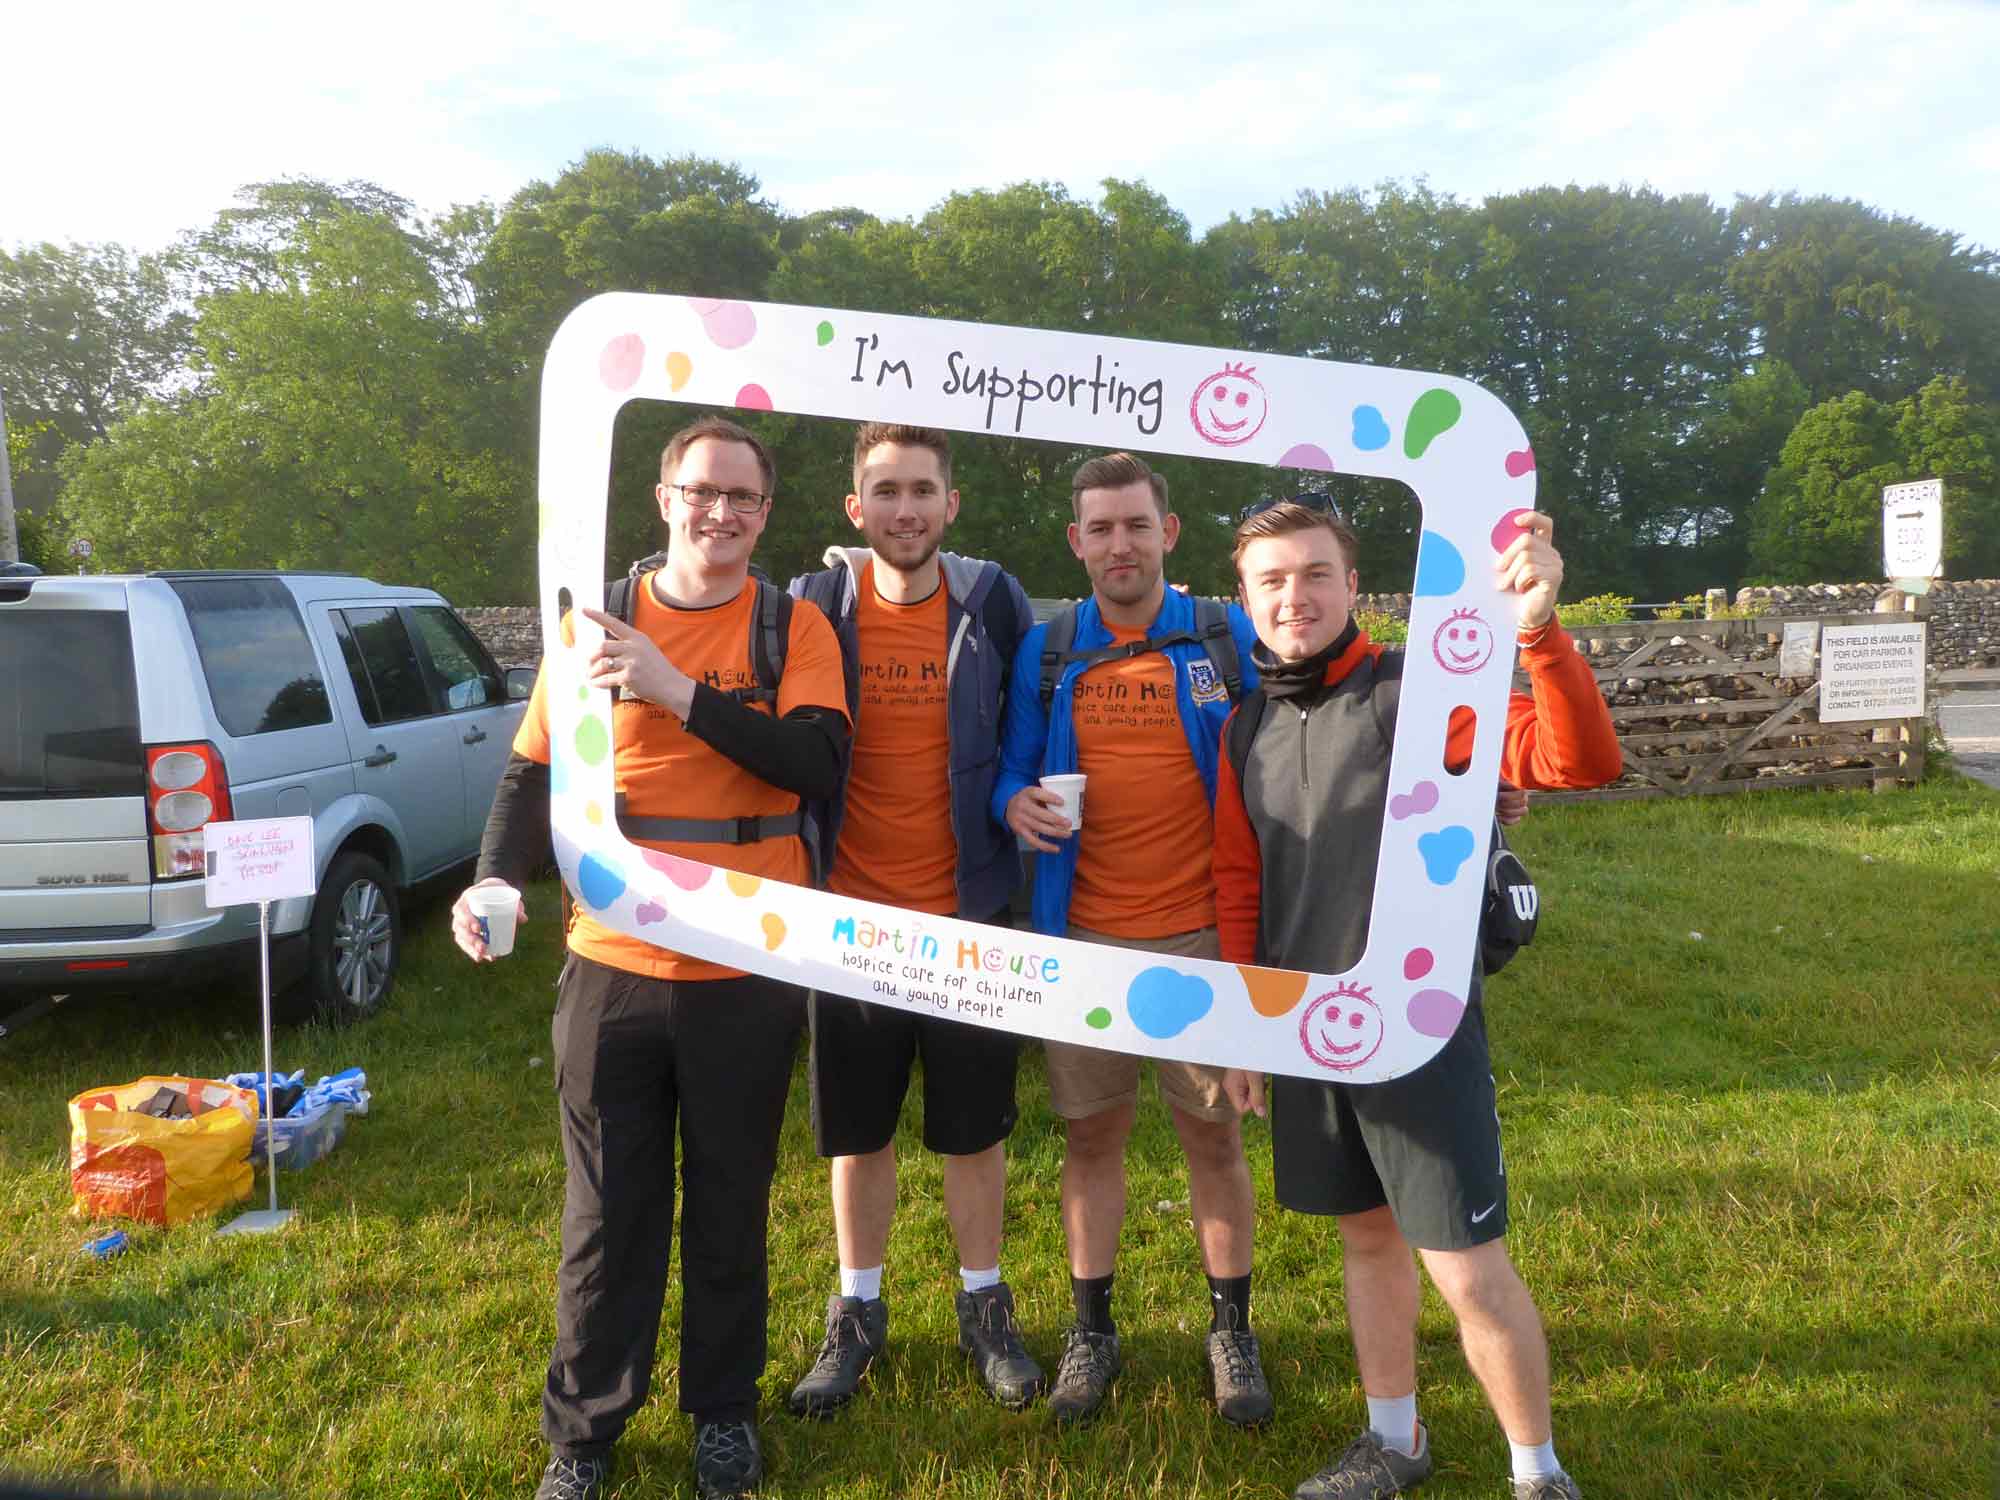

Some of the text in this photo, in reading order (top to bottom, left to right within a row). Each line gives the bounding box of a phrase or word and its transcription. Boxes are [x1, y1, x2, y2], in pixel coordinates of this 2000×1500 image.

[942, 350, 1163, 435] Supporting
[1827, 634, 1922, 647] THIS FIELD IS AVAILABLE
[1833, 650, 1850, 660] FOR
[1851, 648, 1869, 659] CAR
[1870, 647, 1906, 657] PARKING
[1833, 660, 1912, 671] ORGANISED EVENTS
[1073, 675, 1127, 701] artin
[1830, 680, 1845, 689] FOR
[1827, 700, 1861, 710] CONTACT
[1508, 884, 1538, 921] W
[832, 916, 939, 960] Martin
[842, 952, 893, 975] hospice
[902, 966, 934, 983] care
[943, 974, 967, 990] for
[872, 980, 1004, 1018] and young people
